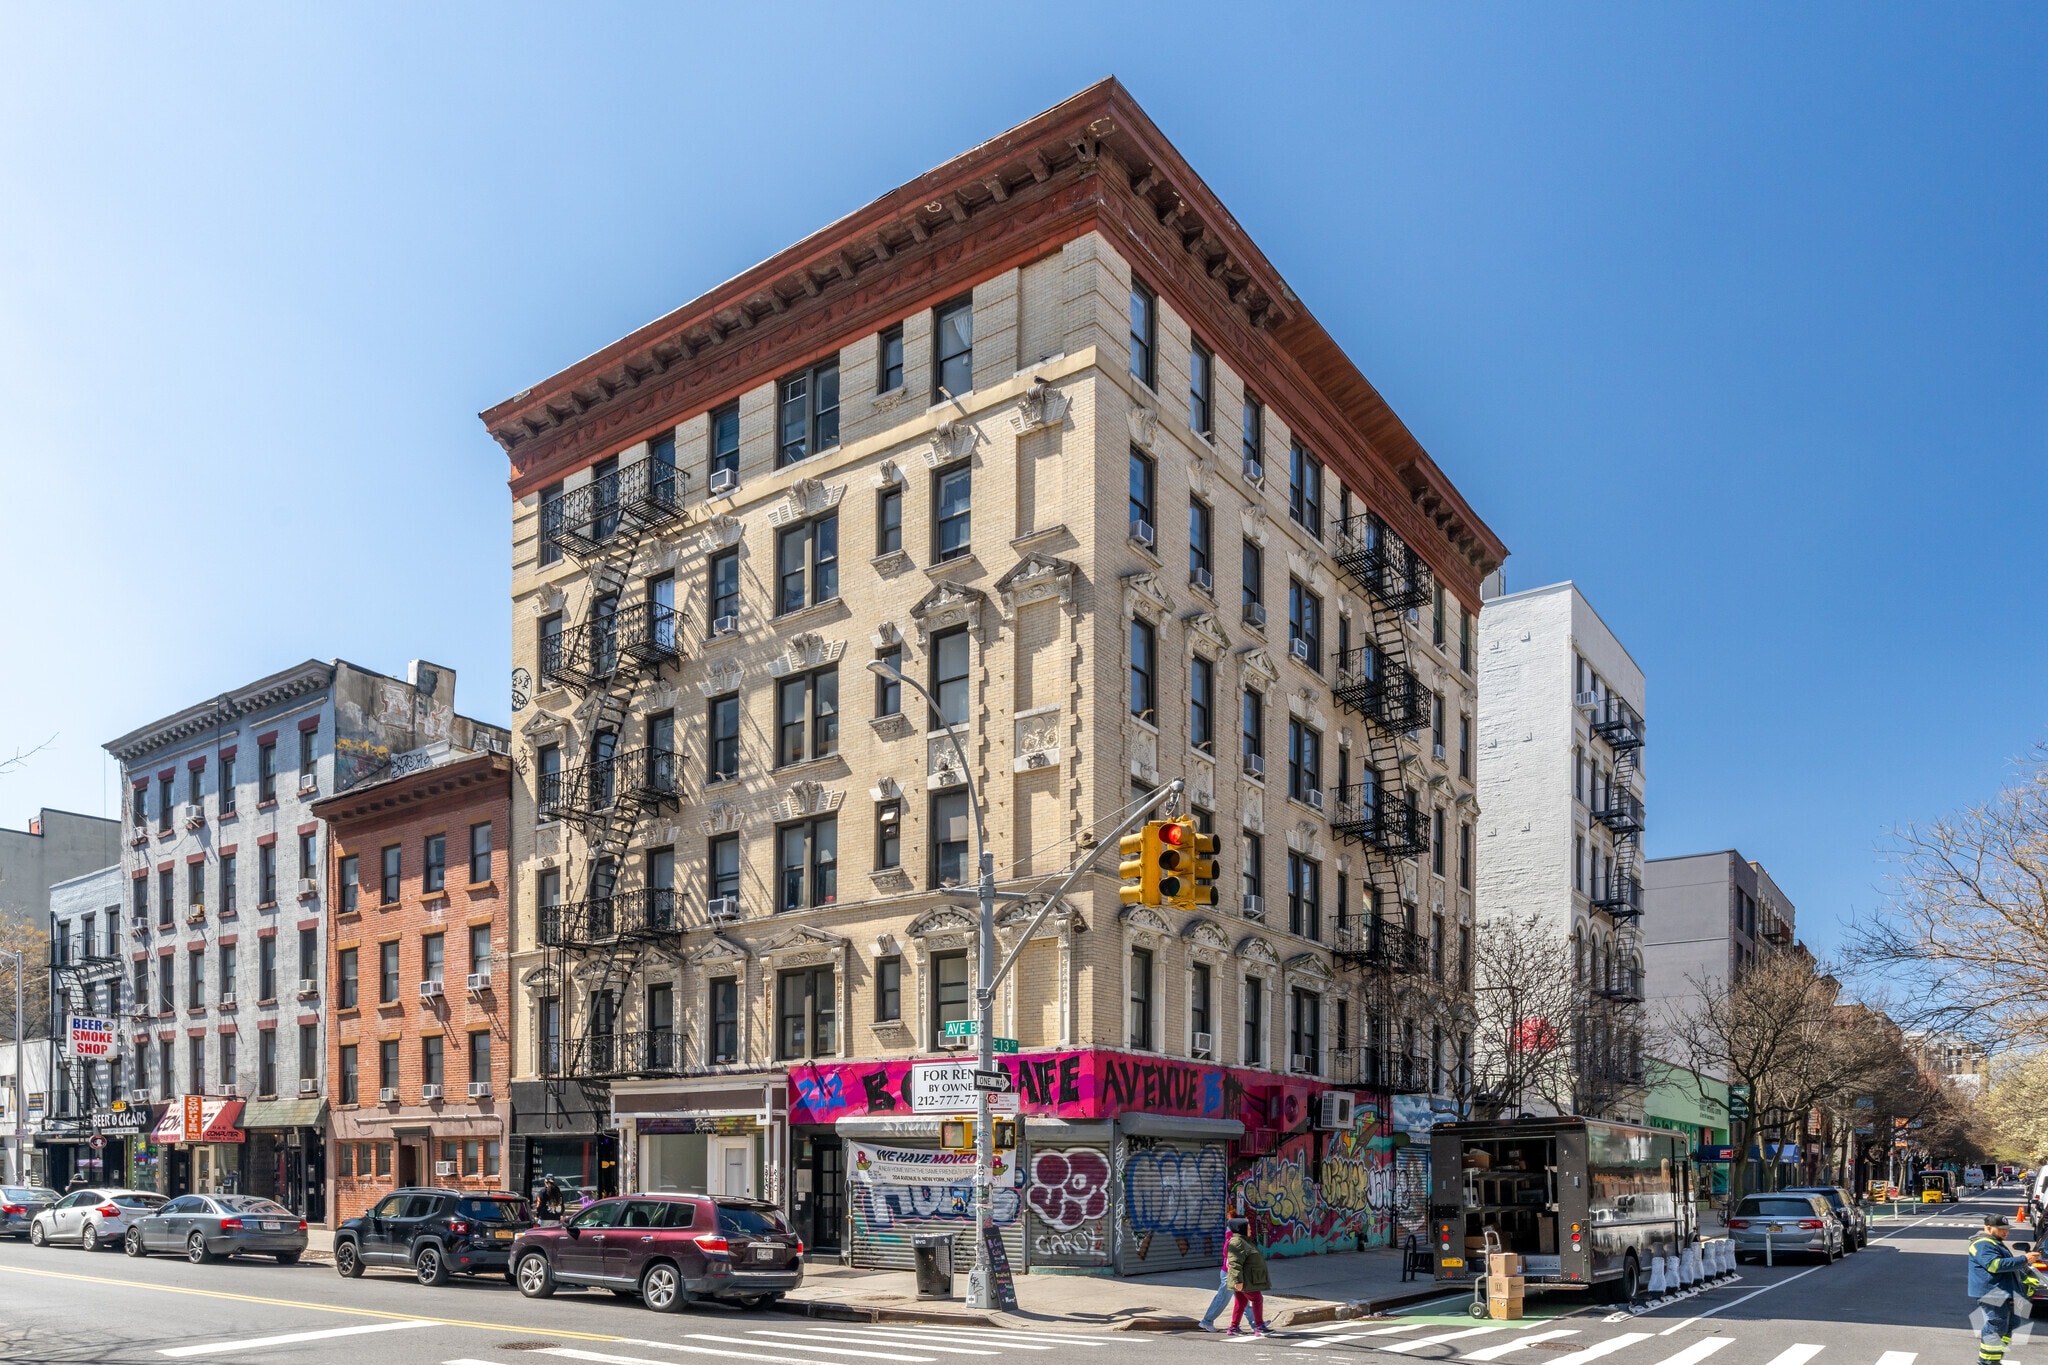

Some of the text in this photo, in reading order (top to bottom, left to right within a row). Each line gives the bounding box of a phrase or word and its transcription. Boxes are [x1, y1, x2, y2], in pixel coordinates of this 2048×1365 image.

[73, 1018, 102, 1031] BEER
[947, 1022, 978, 1034] AVE B
[73, 1030, 112, 1043] SMOKE
[77, 1043, 108, 1055] SHOP
[993, 1040, 998, 1051] E
[1000, 1040, 1010, 1052] 13
[923, 1069, 975, 1081] FOR REN
[862, 1070, 896, 1113] B
[998, 1056, 1080, 1105] AFE
[928, 1083, 973, 1093] BY OWNE
[979, 1076, 1007, 1088] ONE WAY
[1102, 1060, 1222, 1114] AVENUE B
[917, 1094, 978, 1106] 212-777-77
[92, 1113, 110, 1127] BEER
[118, 1111, 147, 1126] CIGARS
[187, 1096, 200, 1132] COMPUTER
[877, 1149, 977, 1165] WE HAVE MOVED
